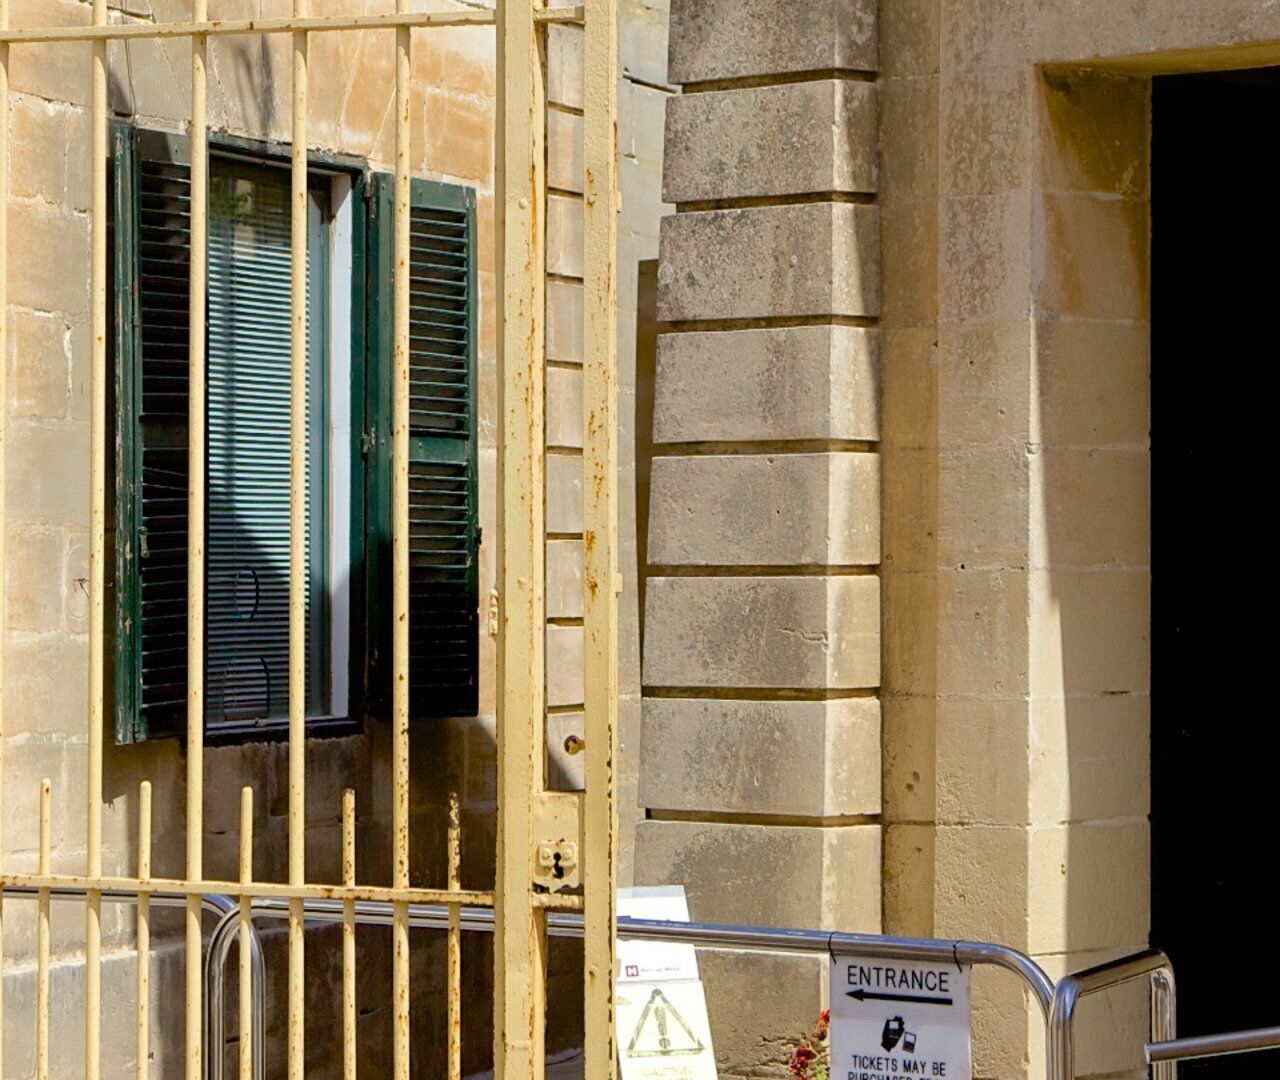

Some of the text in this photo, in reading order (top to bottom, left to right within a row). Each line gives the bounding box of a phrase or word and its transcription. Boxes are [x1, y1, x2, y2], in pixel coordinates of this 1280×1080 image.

[847, 964, 950, 993] ENTRANCE
[852, 1055, 947, 1077] TICKETS MAY BE
